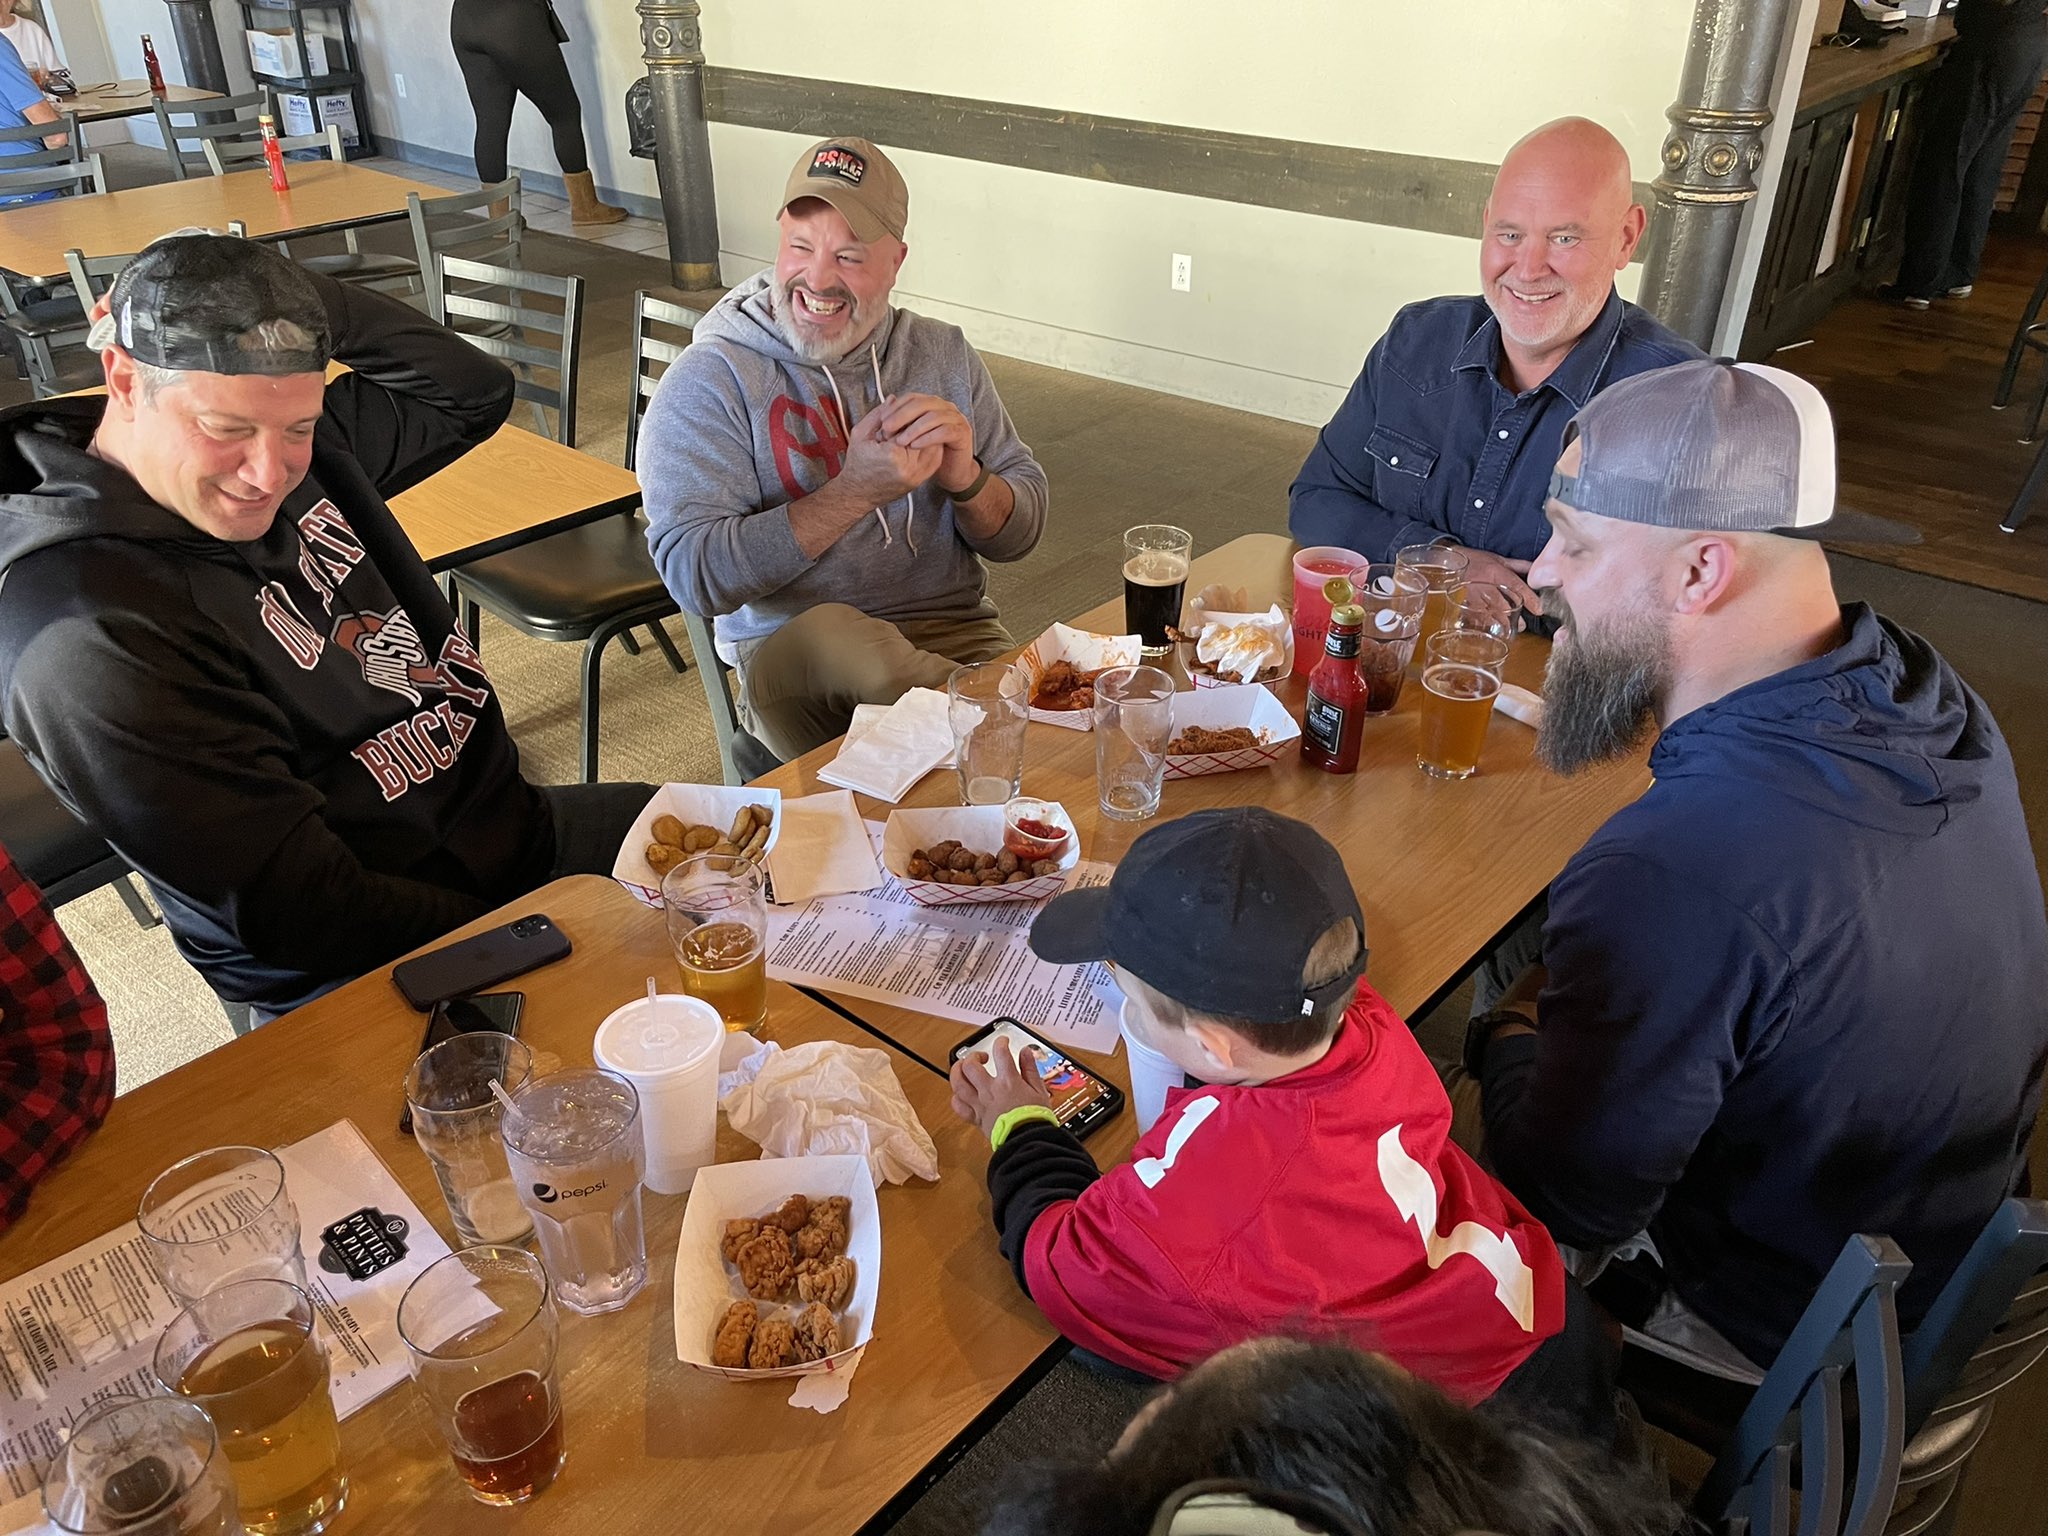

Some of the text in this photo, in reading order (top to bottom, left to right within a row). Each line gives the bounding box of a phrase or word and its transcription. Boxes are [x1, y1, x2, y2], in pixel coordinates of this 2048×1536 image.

[326, 99, 346, 109] Hefty
[362, 608, 423, 663] STAT
[561, 1179, 608, 1200] pepsi
[333, 1223, 379, 1275] & PINTS
[348, 1214, 395, 1266] PATTIES
